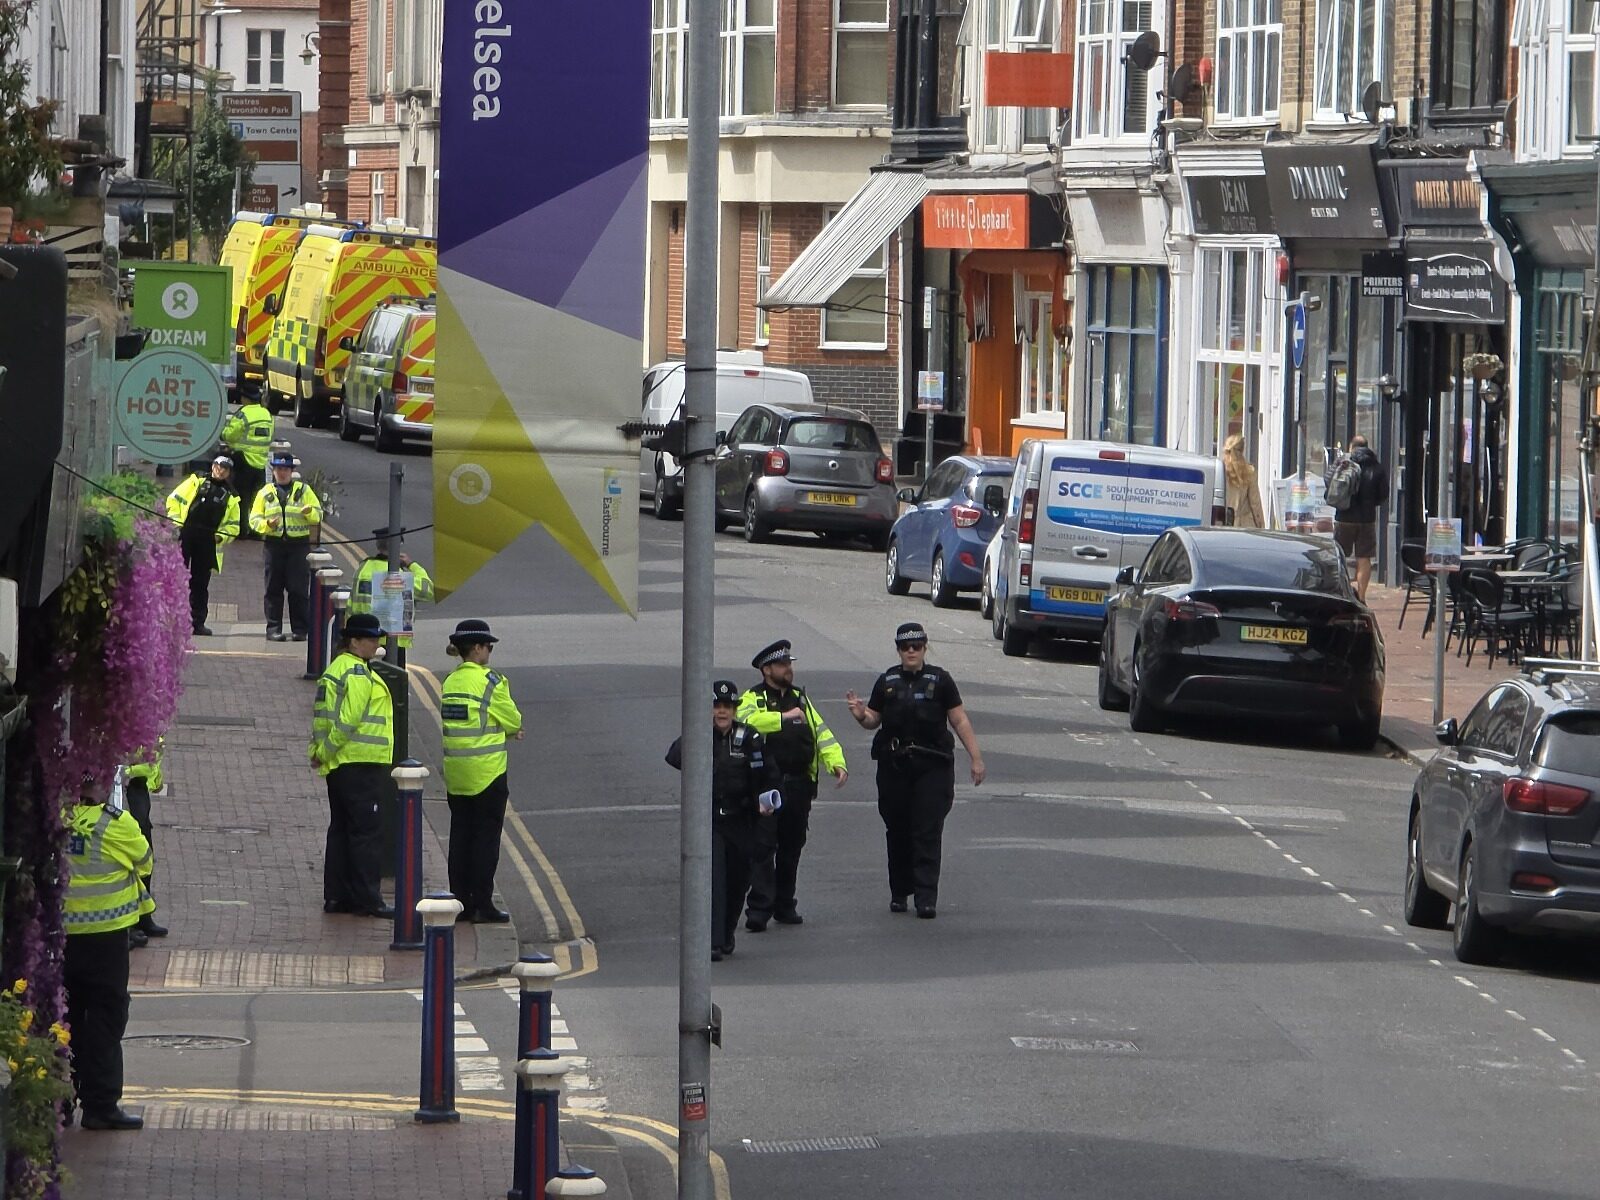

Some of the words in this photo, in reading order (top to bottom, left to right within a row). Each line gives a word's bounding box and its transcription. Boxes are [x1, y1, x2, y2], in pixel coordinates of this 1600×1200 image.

[225, 97, 260, 105] Theatres
[1287, 165, 1347, 200] DYNAMIC
[1220, 180, 1250, 213] DEAN
[353, 262, 436, 278] AMBULANCE
[1363, 276, 1403, 287] PRINTERS
[1363, 287, 1403, 296] PLAYHOUSE
[151, 328, 207, 346] OXFAM
[161, 364, 182, 375] THE
[144, 377, 196, 397] ART
[126, 397, 211, 418] HOUSE
[1058, 481, 1104, 499] SCCE
[1106, 485, 1133, 494] SOUTH
[1134, 487, 1158, 496] COAST
[1160, 489, 1196, 501] CATERING
[1111, 493, 1155, 505] EQUIPMENT
[602, 496, 613, 556] Eastbourne
[1051, 587, 1079, 600] LV69
[1247, 626, 1281, 640] HJ24
[1282, 628, 1306, 641] KGZ
